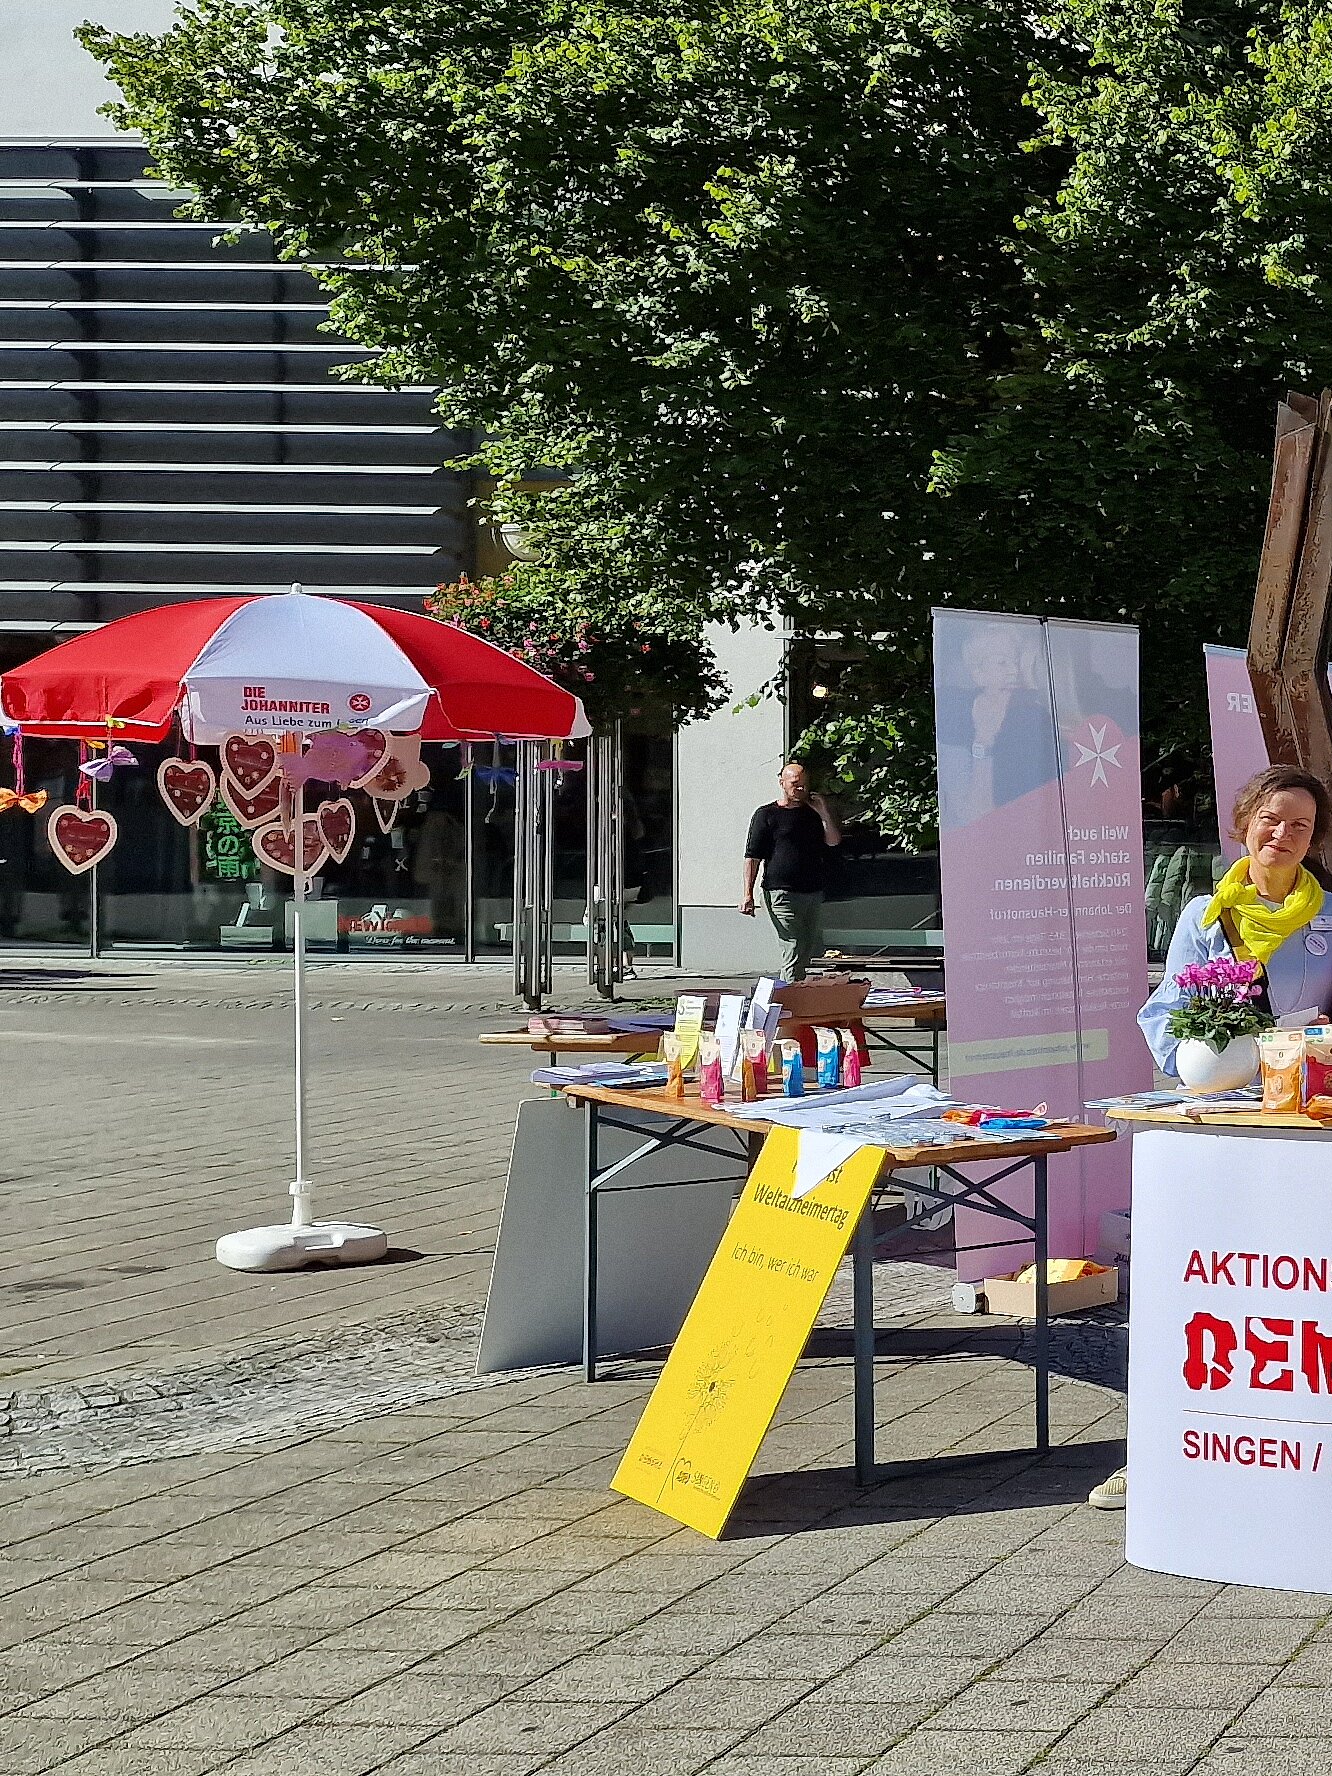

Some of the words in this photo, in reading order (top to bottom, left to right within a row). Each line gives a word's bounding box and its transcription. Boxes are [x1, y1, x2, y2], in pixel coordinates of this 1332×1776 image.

[243, 686, 266, 698] DIE
[241, 699, 330, 714] JOHANNITER
[245, 715, 267, 725] Aus
[272, 715, 304, 727] Liebe
[309, 720, 332, 728] zum
[731, 1242, 747, 1260] Ich
[748, 1245, 764, 1269] bin,
[767, 1257, 785, 1273] wer
[785, 1256, 801, 1276] ich
[801, 1266, 819, 1282] war
[1182, 1431, 1302, 1471] SINGEN
[1311, 1441, 1323, 1473] /
